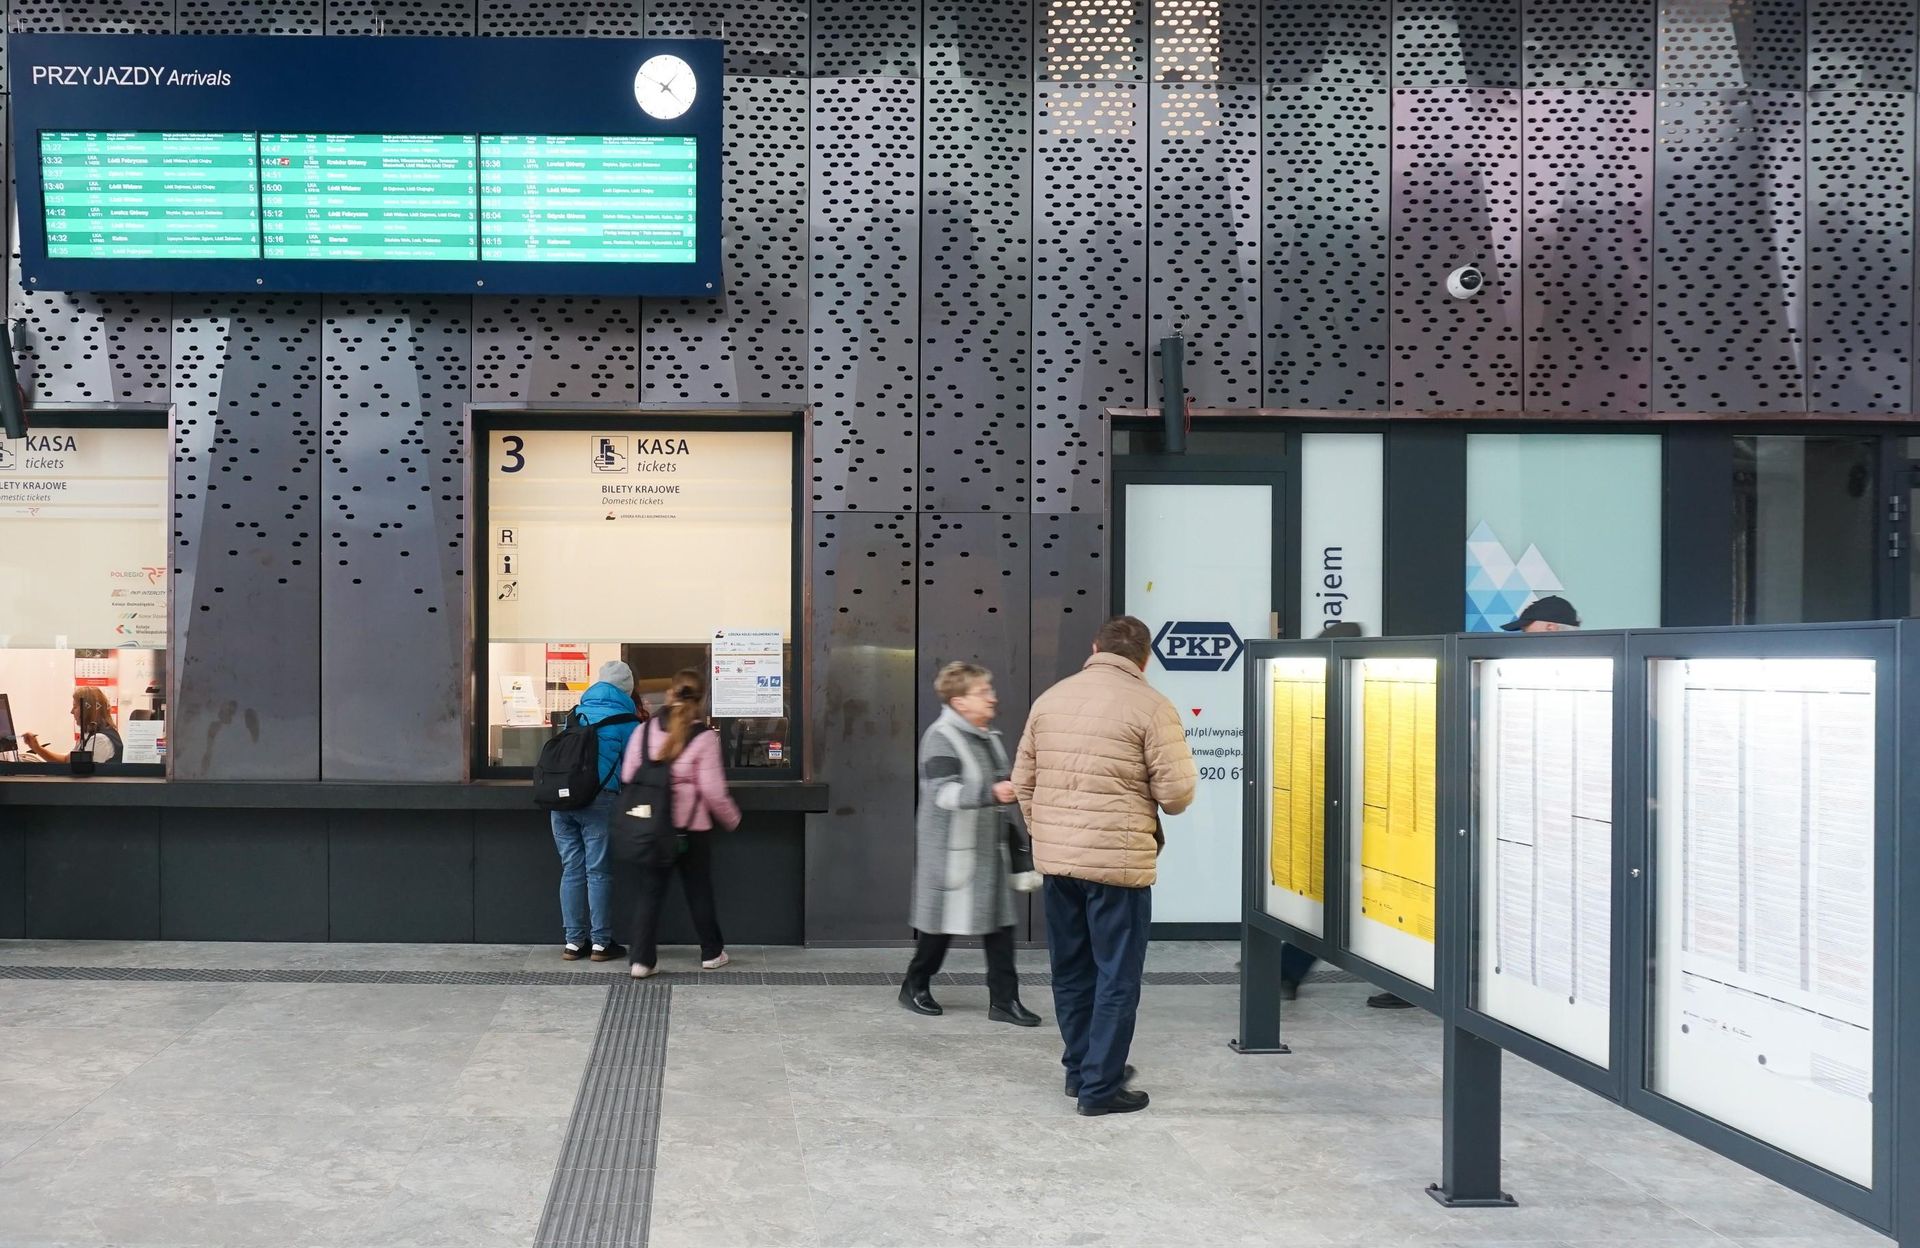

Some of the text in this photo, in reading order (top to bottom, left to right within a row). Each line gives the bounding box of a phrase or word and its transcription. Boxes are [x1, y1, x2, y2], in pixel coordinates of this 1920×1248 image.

[32, 66, 231, 87] PRZYJAZDY Arrivals
[262, 184, 282, 192] 15:00
[249, 209, 255, 217] 4
[468, 212, 474, 220] 3
[26, 436, 77, 451] KASA
[637, 439, 690, 455] KASA
[501, 435, 525, 473] 3
[25, 458, 64, 469] tickets
[637, 461, 677, 473] tickets
[23, 482, 67, 490] KRAJOWE
[602, 486, 680, 494] BILETY KRAJOWE
[602, 497, 664, 505] Domestic tickets
[502, 529, 513, 543] R
[1167, 636, 1231, 656] PKP
[1200, 767, 1244, 780] 920 6
